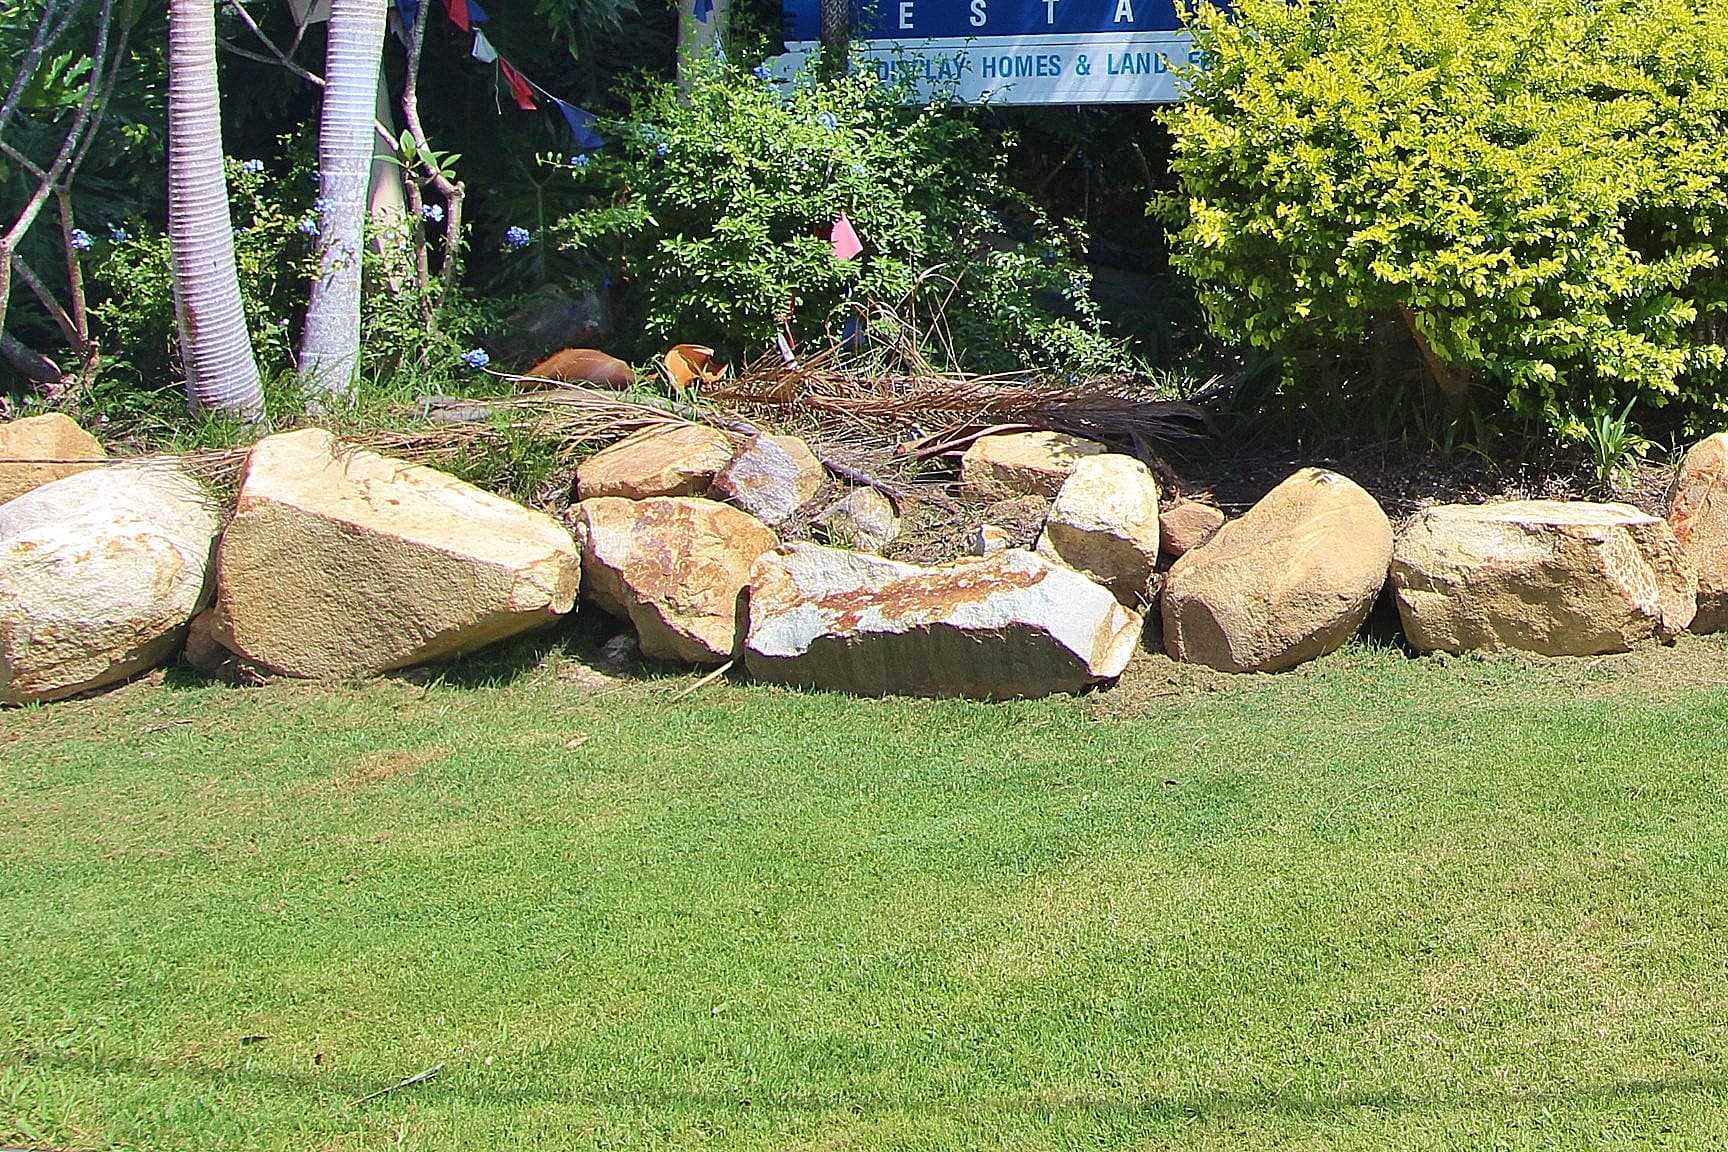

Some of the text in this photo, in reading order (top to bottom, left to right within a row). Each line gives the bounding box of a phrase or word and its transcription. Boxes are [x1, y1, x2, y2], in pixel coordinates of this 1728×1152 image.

[877, 56, 967, 81] DIPLAY
[982, 54, 1062, 78] HOMES
[1075, 54, 1091, 76] &
[1107, 52, 1168, 75] LAND
